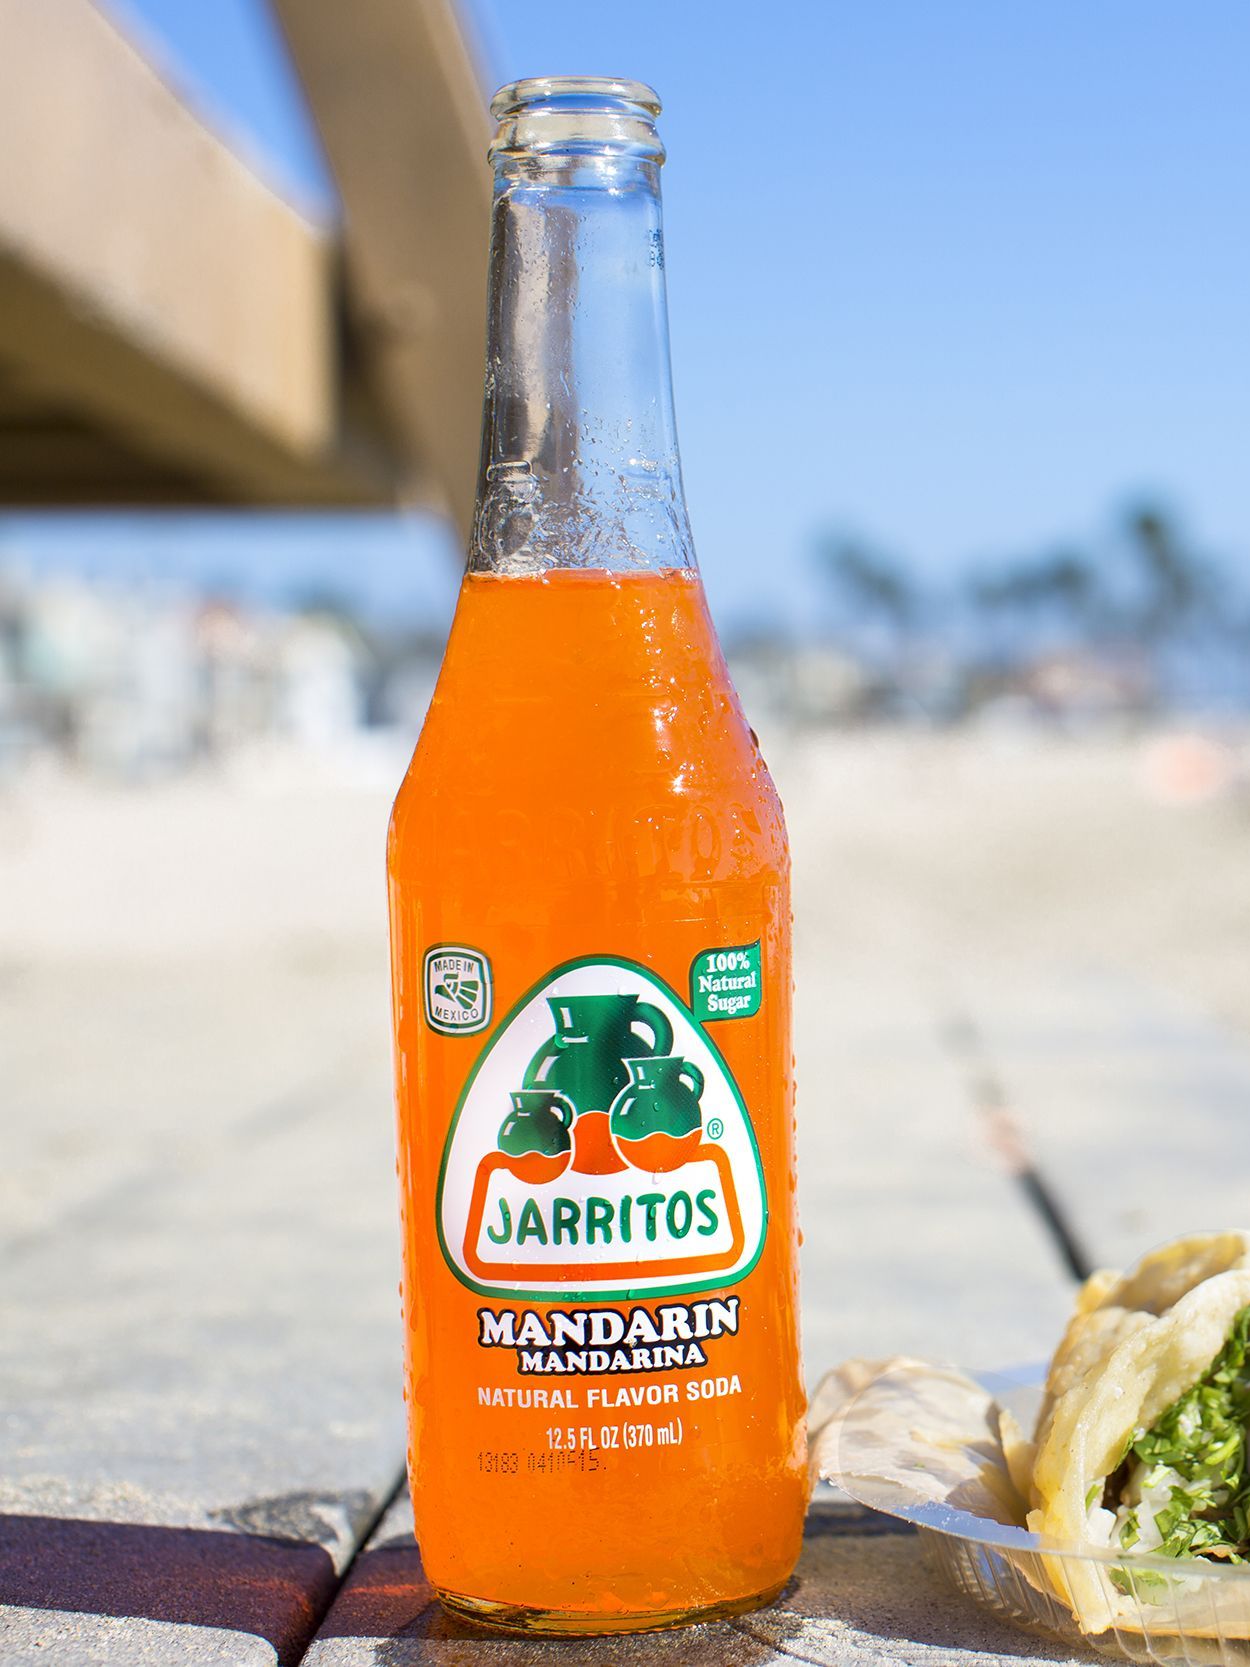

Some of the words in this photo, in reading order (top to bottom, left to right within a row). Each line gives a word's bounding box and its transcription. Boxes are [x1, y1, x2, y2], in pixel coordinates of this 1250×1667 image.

[434, 959, 461, 973] MADE
[463, 961, 474, 973] IN
[706, 952, 750, 973] 100%
[698, 971, 757, 993] Natural
[434, 1005, 479, 1021] MEXICO
[707, 993, 752, 1015] Sugar
[487, 1188, 719, 1246] JARRITOS
[479, 1298, 739, 1347] MANDARIN
[520, 1343, 706, 1373] MANDARINA
[477, 1386, 579, 1409] NATURAL
[587, 1383, 679, 1409] FLAVOR
[686, 1374, 742, 1401] SODA
[546, 1427, 576, 1450] 12.5
[580, 1426, 597, 1450] FL
[601, 1425, 620, 1449] OZ
[623, 1421, 653, 1449] (370
[657, 1416, 683, 1447] mL)
